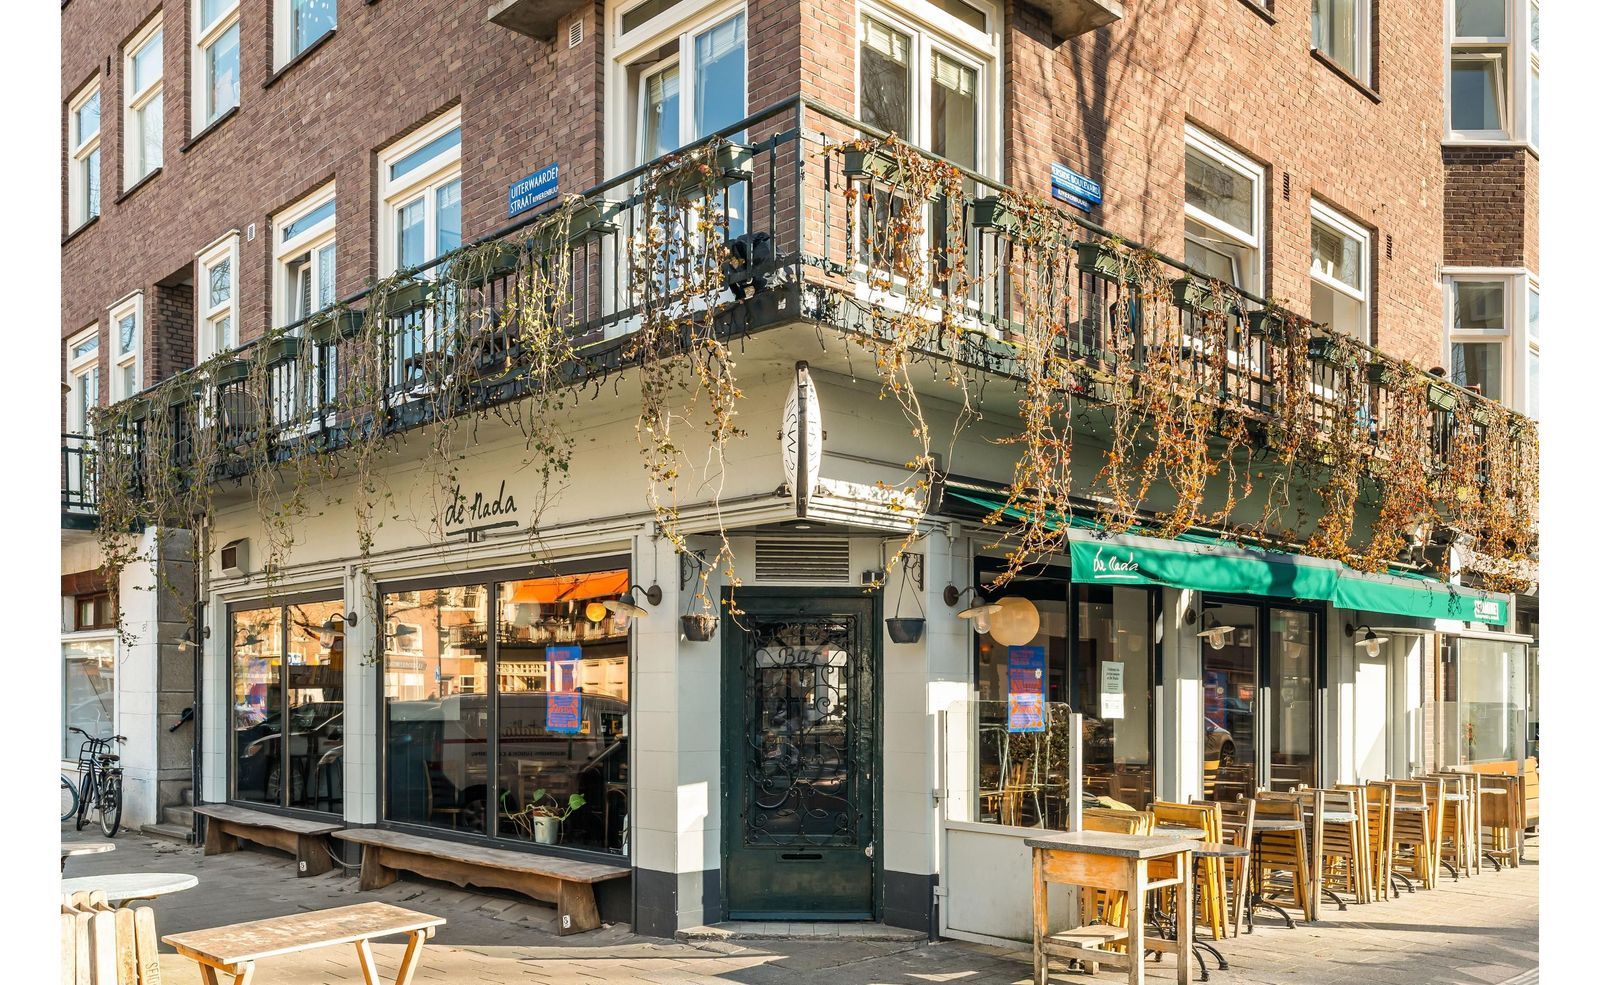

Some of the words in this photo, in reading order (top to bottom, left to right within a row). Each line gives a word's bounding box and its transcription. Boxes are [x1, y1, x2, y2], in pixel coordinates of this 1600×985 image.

[510, 193, 533, 214] STRAAT
[445, 484, 464, 527] de
[471, 479, 518, 520] Nada
